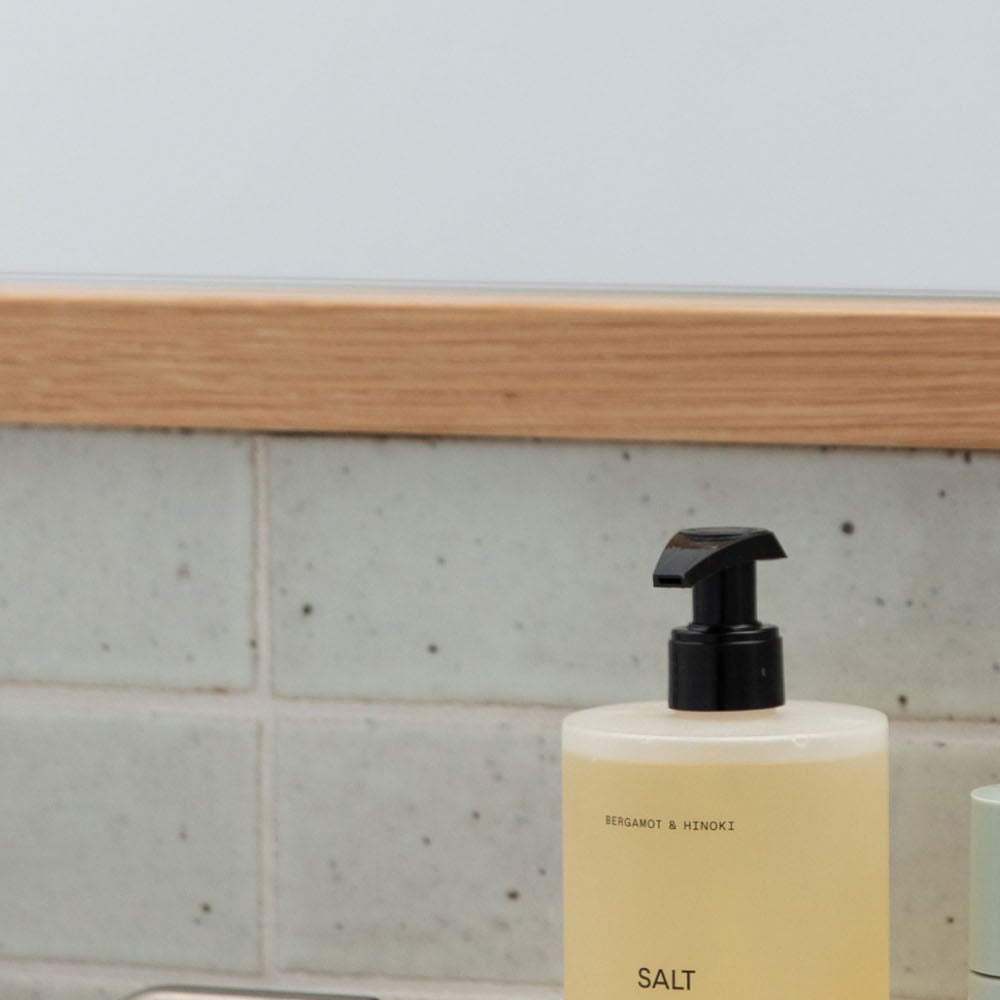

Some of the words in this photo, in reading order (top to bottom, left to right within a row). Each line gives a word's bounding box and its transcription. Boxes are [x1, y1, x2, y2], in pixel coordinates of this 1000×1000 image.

[605, 815, 662, 829] BERGAMOT
[668, 820, 677, 830] &
[683, 821, 735, 831] HINOKI
[638, 967, 696, 990] SALT
